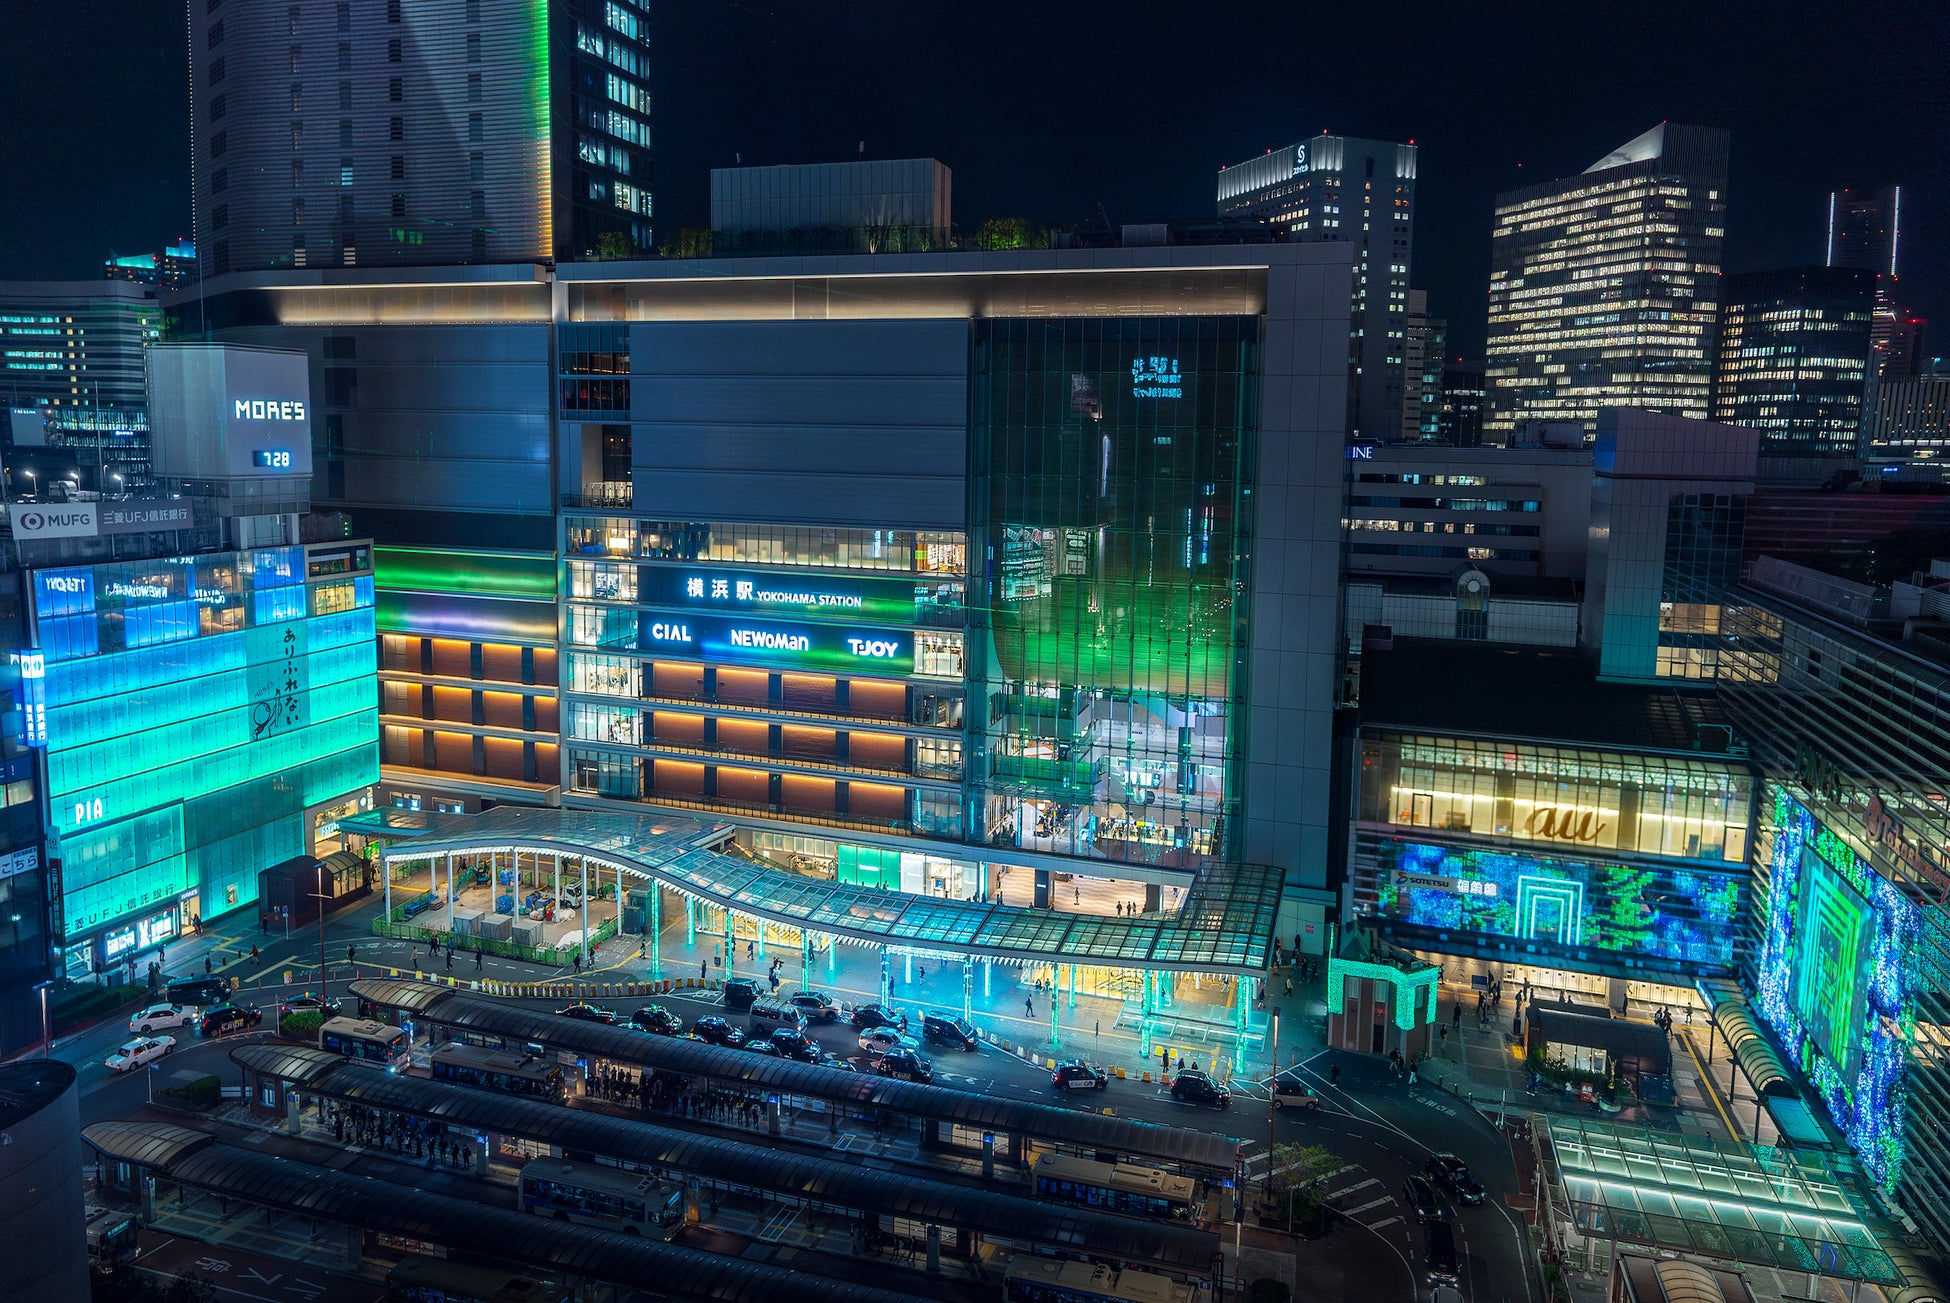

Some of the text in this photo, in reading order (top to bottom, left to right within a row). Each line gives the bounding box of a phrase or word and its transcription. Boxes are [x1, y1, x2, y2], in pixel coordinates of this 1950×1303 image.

[235, 399, 306, 421] MORE'S
[48, 513, 91, 528] MUFG
[102, 507, 188, 525] 三菱UFJ信託銀行
[686, 577, 754, 601] 横浜駅
[757, 590, 863, 608] YOKOHAMA STATION
[652, 623, 692, 643] CIAL
[730, 629, 809, 652] NEWoMan
[283, 627, 299, 726] ありふれない
[75, 798, 104, 825] PIA
[1525, 806, 1607, 843] au
[1410, 876, 1449, 888] SOTETSU
